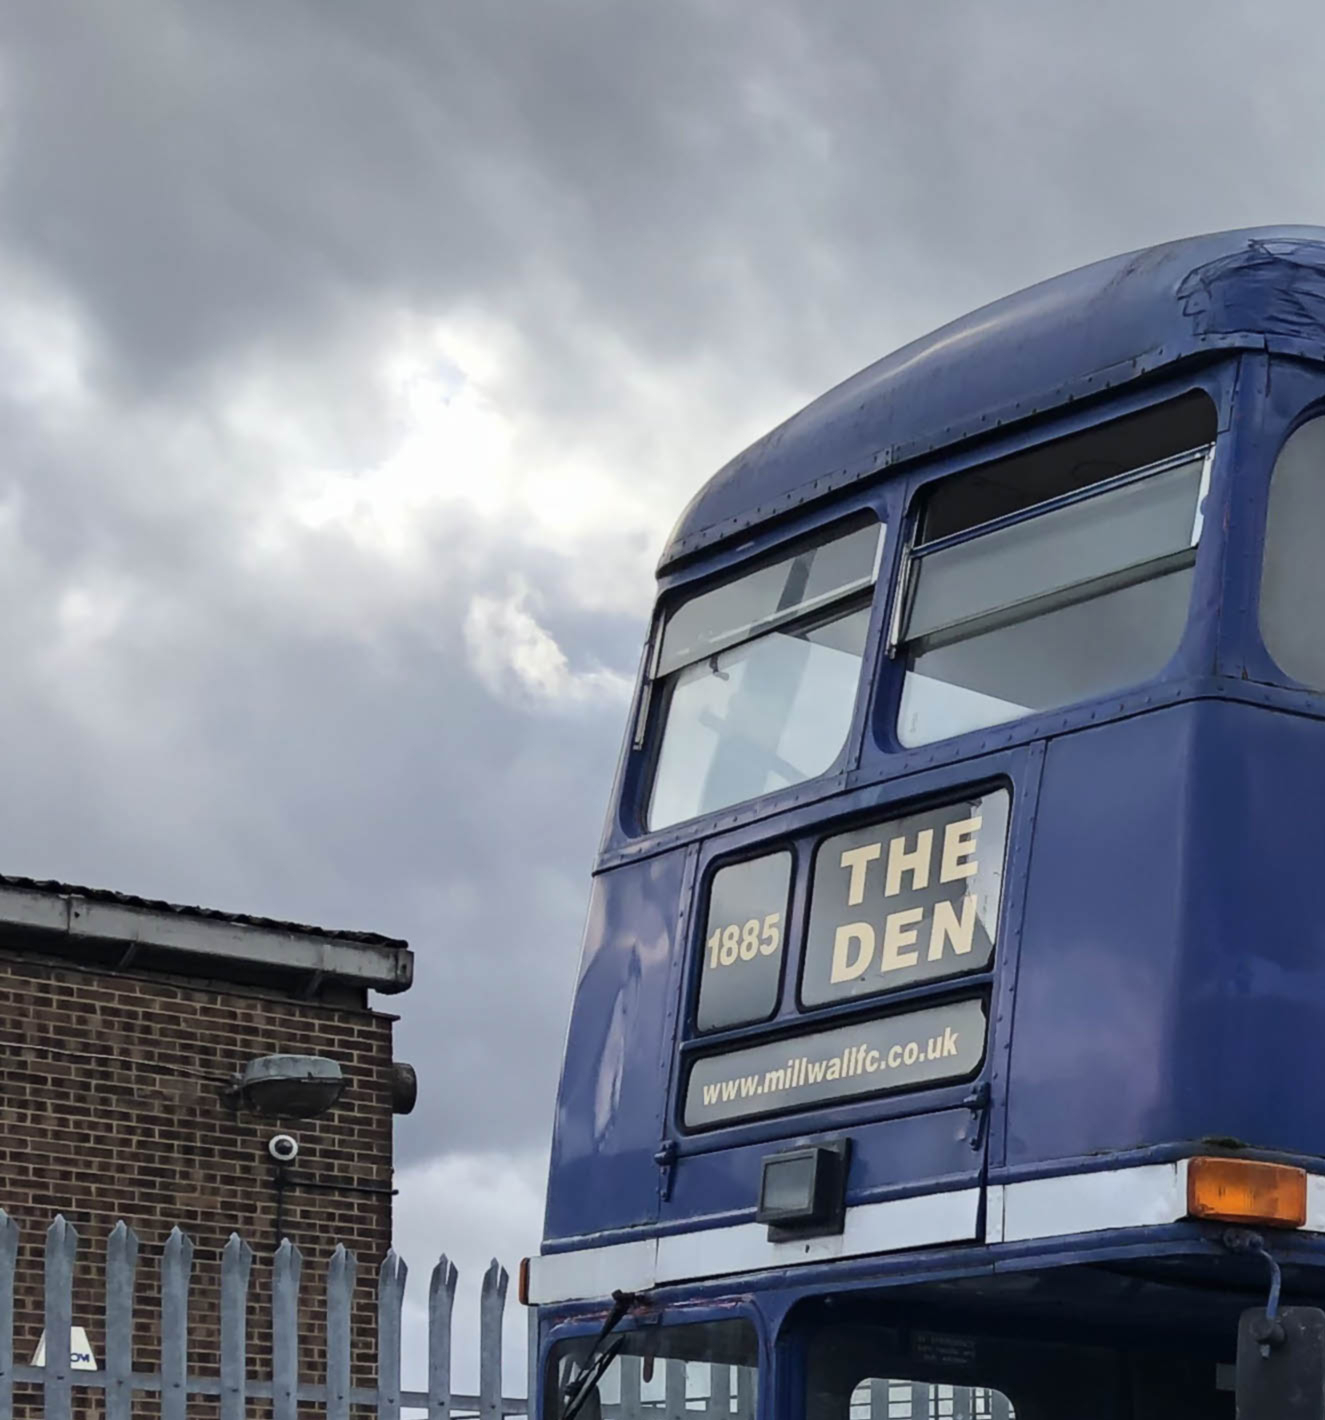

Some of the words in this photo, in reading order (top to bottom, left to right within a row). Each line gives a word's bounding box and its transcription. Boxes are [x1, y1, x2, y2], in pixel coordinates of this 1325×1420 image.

[840, 816, 983, 906] THE
[708, 913, 781, 968] 1885
[830, 895, 977, 984] DEN
[703, 1027, 959, 1105] www.millwallfc.co.uk
